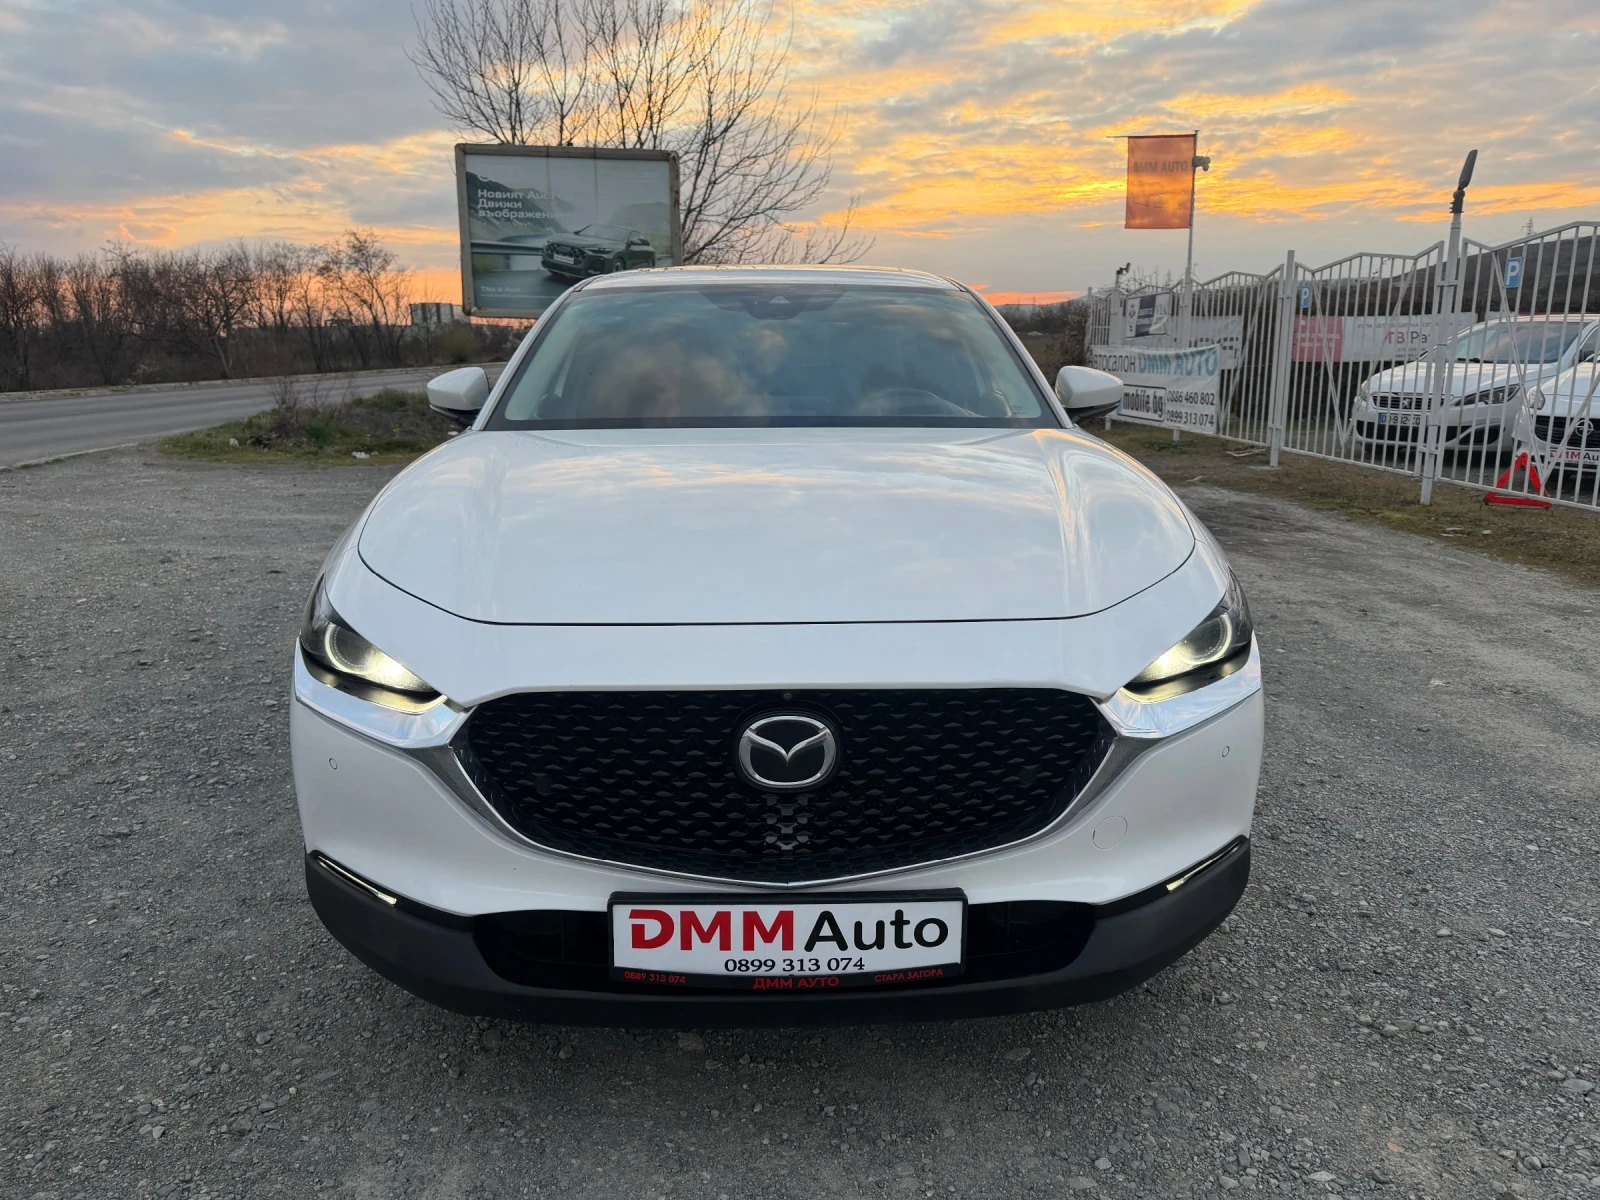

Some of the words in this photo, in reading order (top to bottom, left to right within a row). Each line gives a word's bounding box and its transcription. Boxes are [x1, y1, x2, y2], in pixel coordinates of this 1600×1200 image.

[1161, 160, 1188, 173] AUTO
[477, 188, 524, 199] Новият
[477, 198, 523, 209] Движи
[1506, 261, 1520, 286] P
[1301, 287, 1309, 306] P
[1174, 347, 1218, 377] AUTO
[1184, 391, 1199, 404] 460
[1200, 392, 1215, 406] 802
[1184, 410, 1198, 425] 313
[1199, 411, 1215, 427] 074
[628, 908, 794, 952] DMM
[804, 908, 949, 953] Auto
[724, 957, 776, 972] 0899
[782, 957, 821, 972] 313
[826, 956, 865, 972] 074
[624, 971, 647, 981] 0889
[649, 973, 667, 983] 313
[668, 974, 686, 984] 074
[753, 977, 793, 990] ДММ
[797, 976, 839, 988] АУТО
[874, 973, 905, 983] СТАРА
[907, 969, 944, 980] ЗАГОРА
